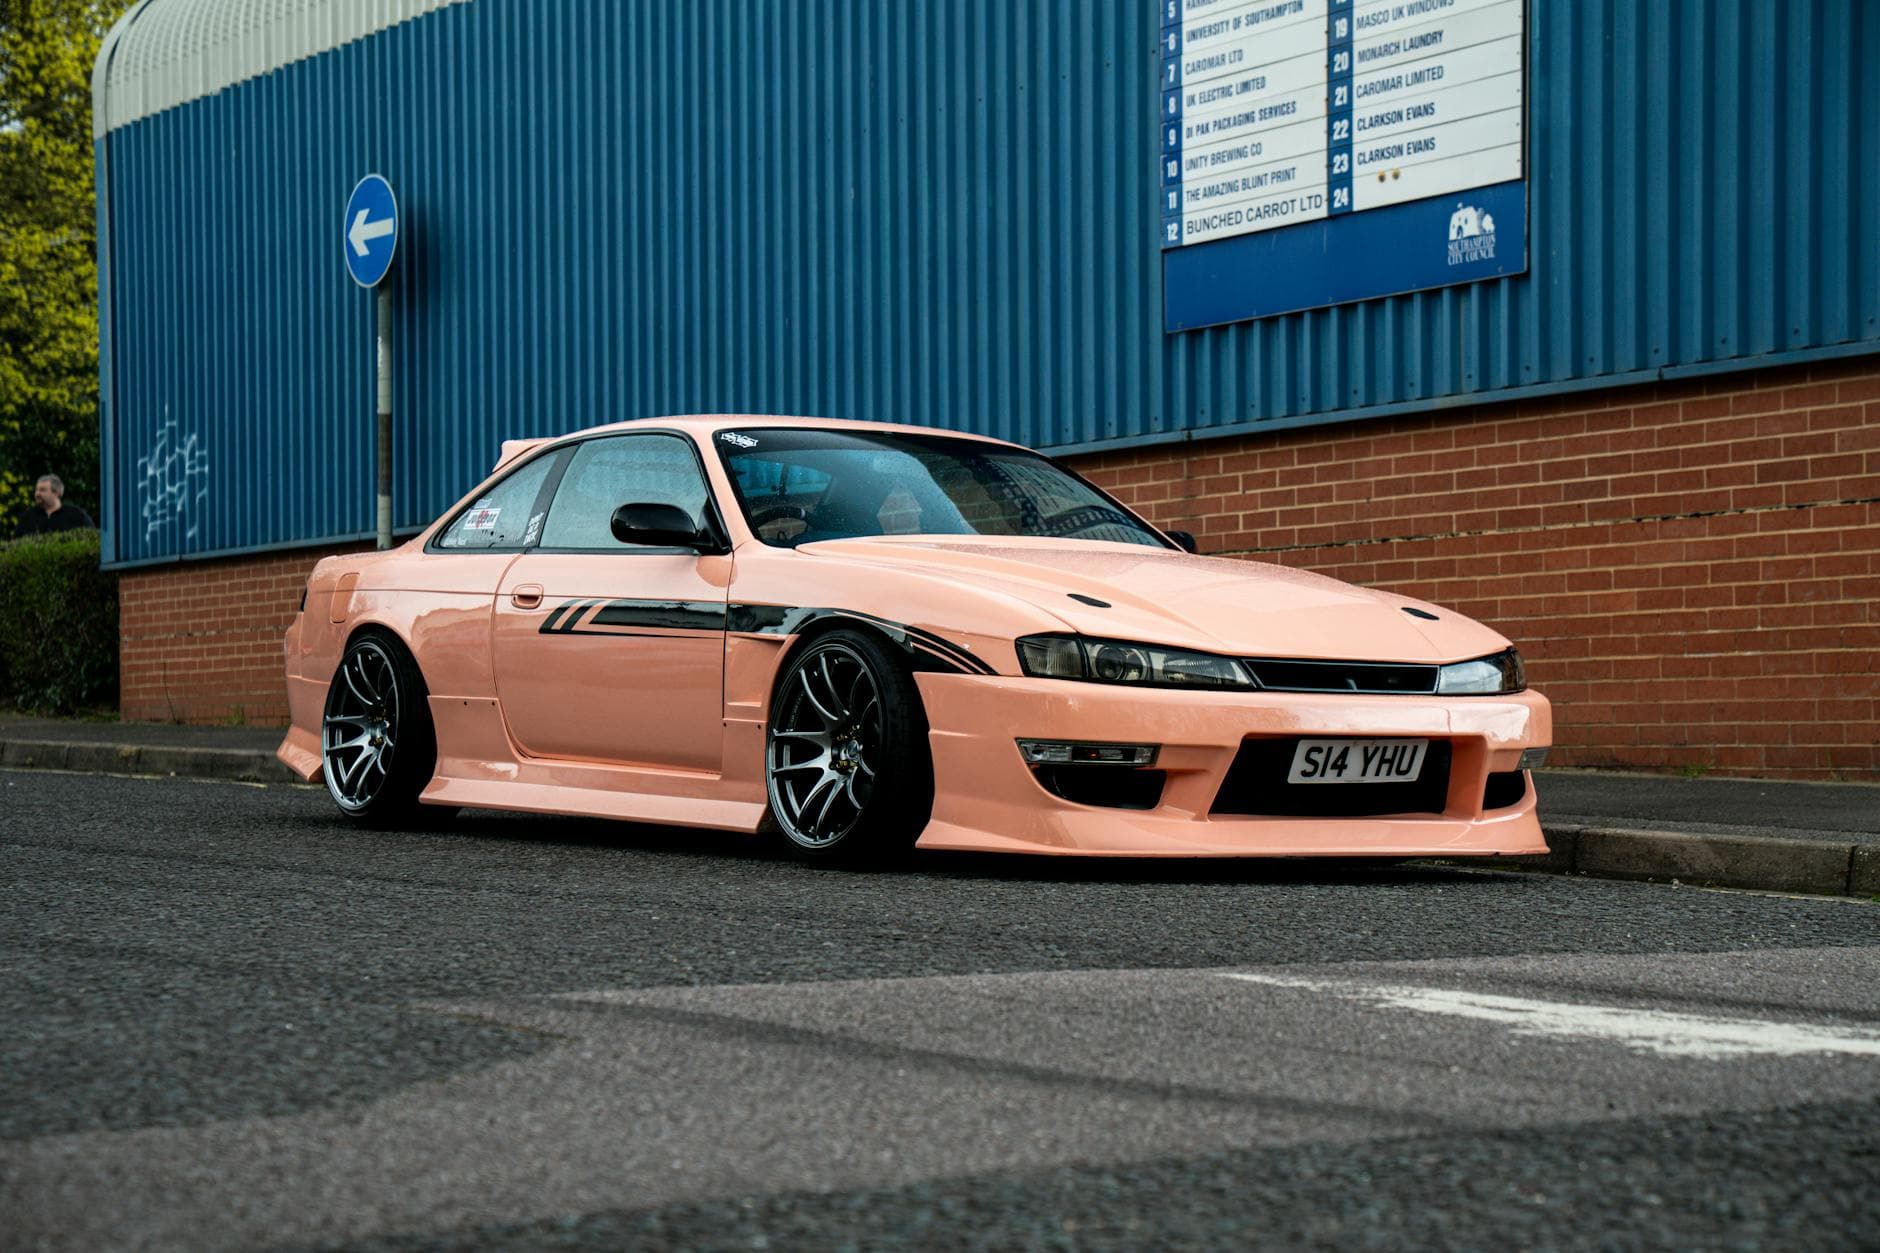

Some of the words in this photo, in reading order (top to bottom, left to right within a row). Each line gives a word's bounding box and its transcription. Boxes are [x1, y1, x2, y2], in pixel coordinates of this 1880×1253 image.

[1168, 1, 1176, 18] 5
[1168, 33, 1176, 50] 6
[1186, 20, 1229, 43] UNIVERSITY
[1232, 16, 1241, 30] OF
[1245, 1, 1303, 27] SOUTHAMPTON
[1335, 17, 1348, 39] 19
[1356, 9, 1389, 30] MASCO
[1392, 6, 1405, 21] UK
[1168, 64, 1176, 82] 7
[1185, 53, 1225, 75] CAROMAR
[1228, 49, 1244, 64] LTD
[1333, 51, 1349, 73] 20
[1357, 41, 1400, 64] MONARCH
[1403, 29, 1444, 51] LAUNDRY
[1168, 97, 1176, 114] 8
[1186, 93, 1196, 107] UK
[1199, 84, 1233, 104] ELECTRIC
[1235, 76, 1266, 95] LIMITED
[1334, 85, 1347, 107] 21
[1356, 75, 1402, 98] CAROMAR
[1405, 65, 1444, 87] LIMITED
[1168, 128, 1176, 146] 9
[1195, 124, 1209, 136] PAK
[1213, 111, 1255, 134] PACKAGING
[1258, 101, 1297, 121] SERVICES
[1333, 119, 1349, 141] 22
[1357, 110, 1405, 131] CLARKSON
[1406, 102, 1436, 121] EVANS
[1167, 160, 1178, 178] 10
[1185, 155, 1208, 171] UNITY
[1210, 145, 1248, 166] BREWING
[1250, 142, 1262, 156] CO
[1333, 153, 1349, 174] 23
[1357, 144, 1405, 166] CLARKSON
[1406, 137, 1436, 156] EVANS
[1168, 191, 1177, 210] 11
[1186, 190, 1200, 202] THE
[1202, 182, 1239, 199] AMAZING
[1241, 174, 1268, 191] BLUNT
[1270, 167, 1296, 182] PRINT
[1333, 187, 1349, 208] 24
[1167, 222, 1178, 241] 12
[1187, 210, 1243, 235] BUNCHED
[1246, 199, 1296, 222] CARROT
[1299, 194, 1323, 212] LTD
[1300, 746, 1350, 777] S14
[1360, 745, 1418, 777] YHU
